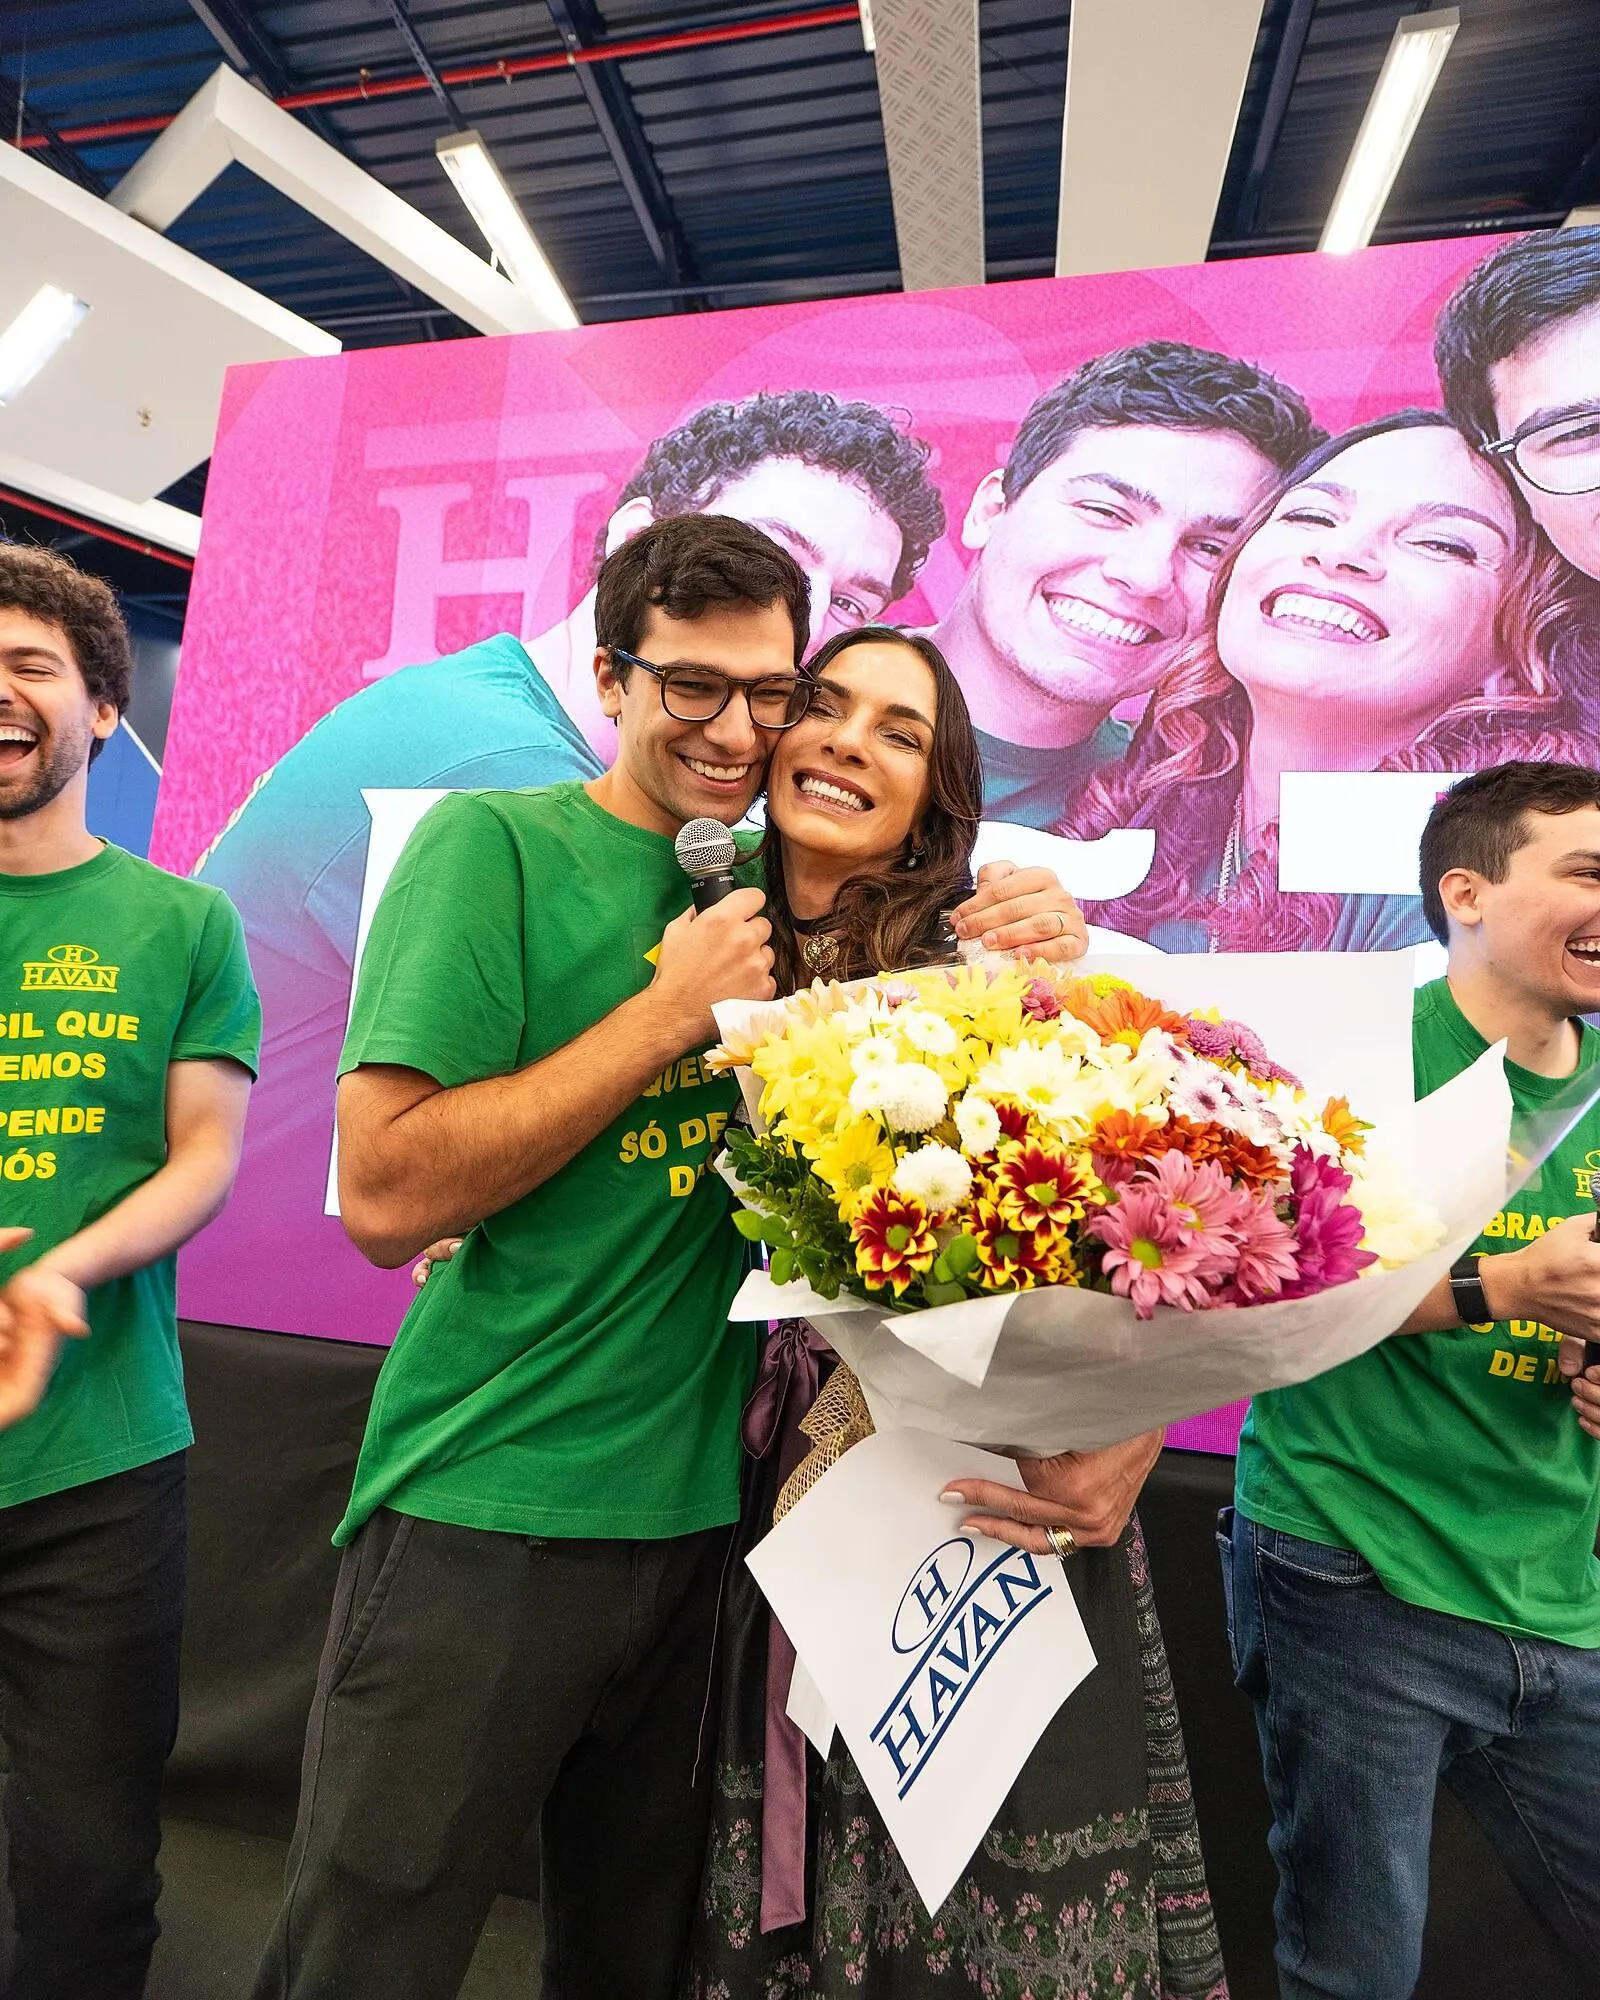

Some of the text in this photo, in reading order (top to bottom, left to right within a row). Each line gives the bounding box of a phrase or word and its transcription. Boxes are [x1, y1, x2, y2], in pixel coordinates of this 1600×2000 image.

[22, 967, 118, 988] HAVAN
[56, 1010, 140, 1041] QUE
[619, 1120, 667, 1163] SÓ
[1488, 1349, 1538, 1382] DE
[911, 1558, 953, 1629] H
[879, 1552, 1043, 1785] HAVAN
